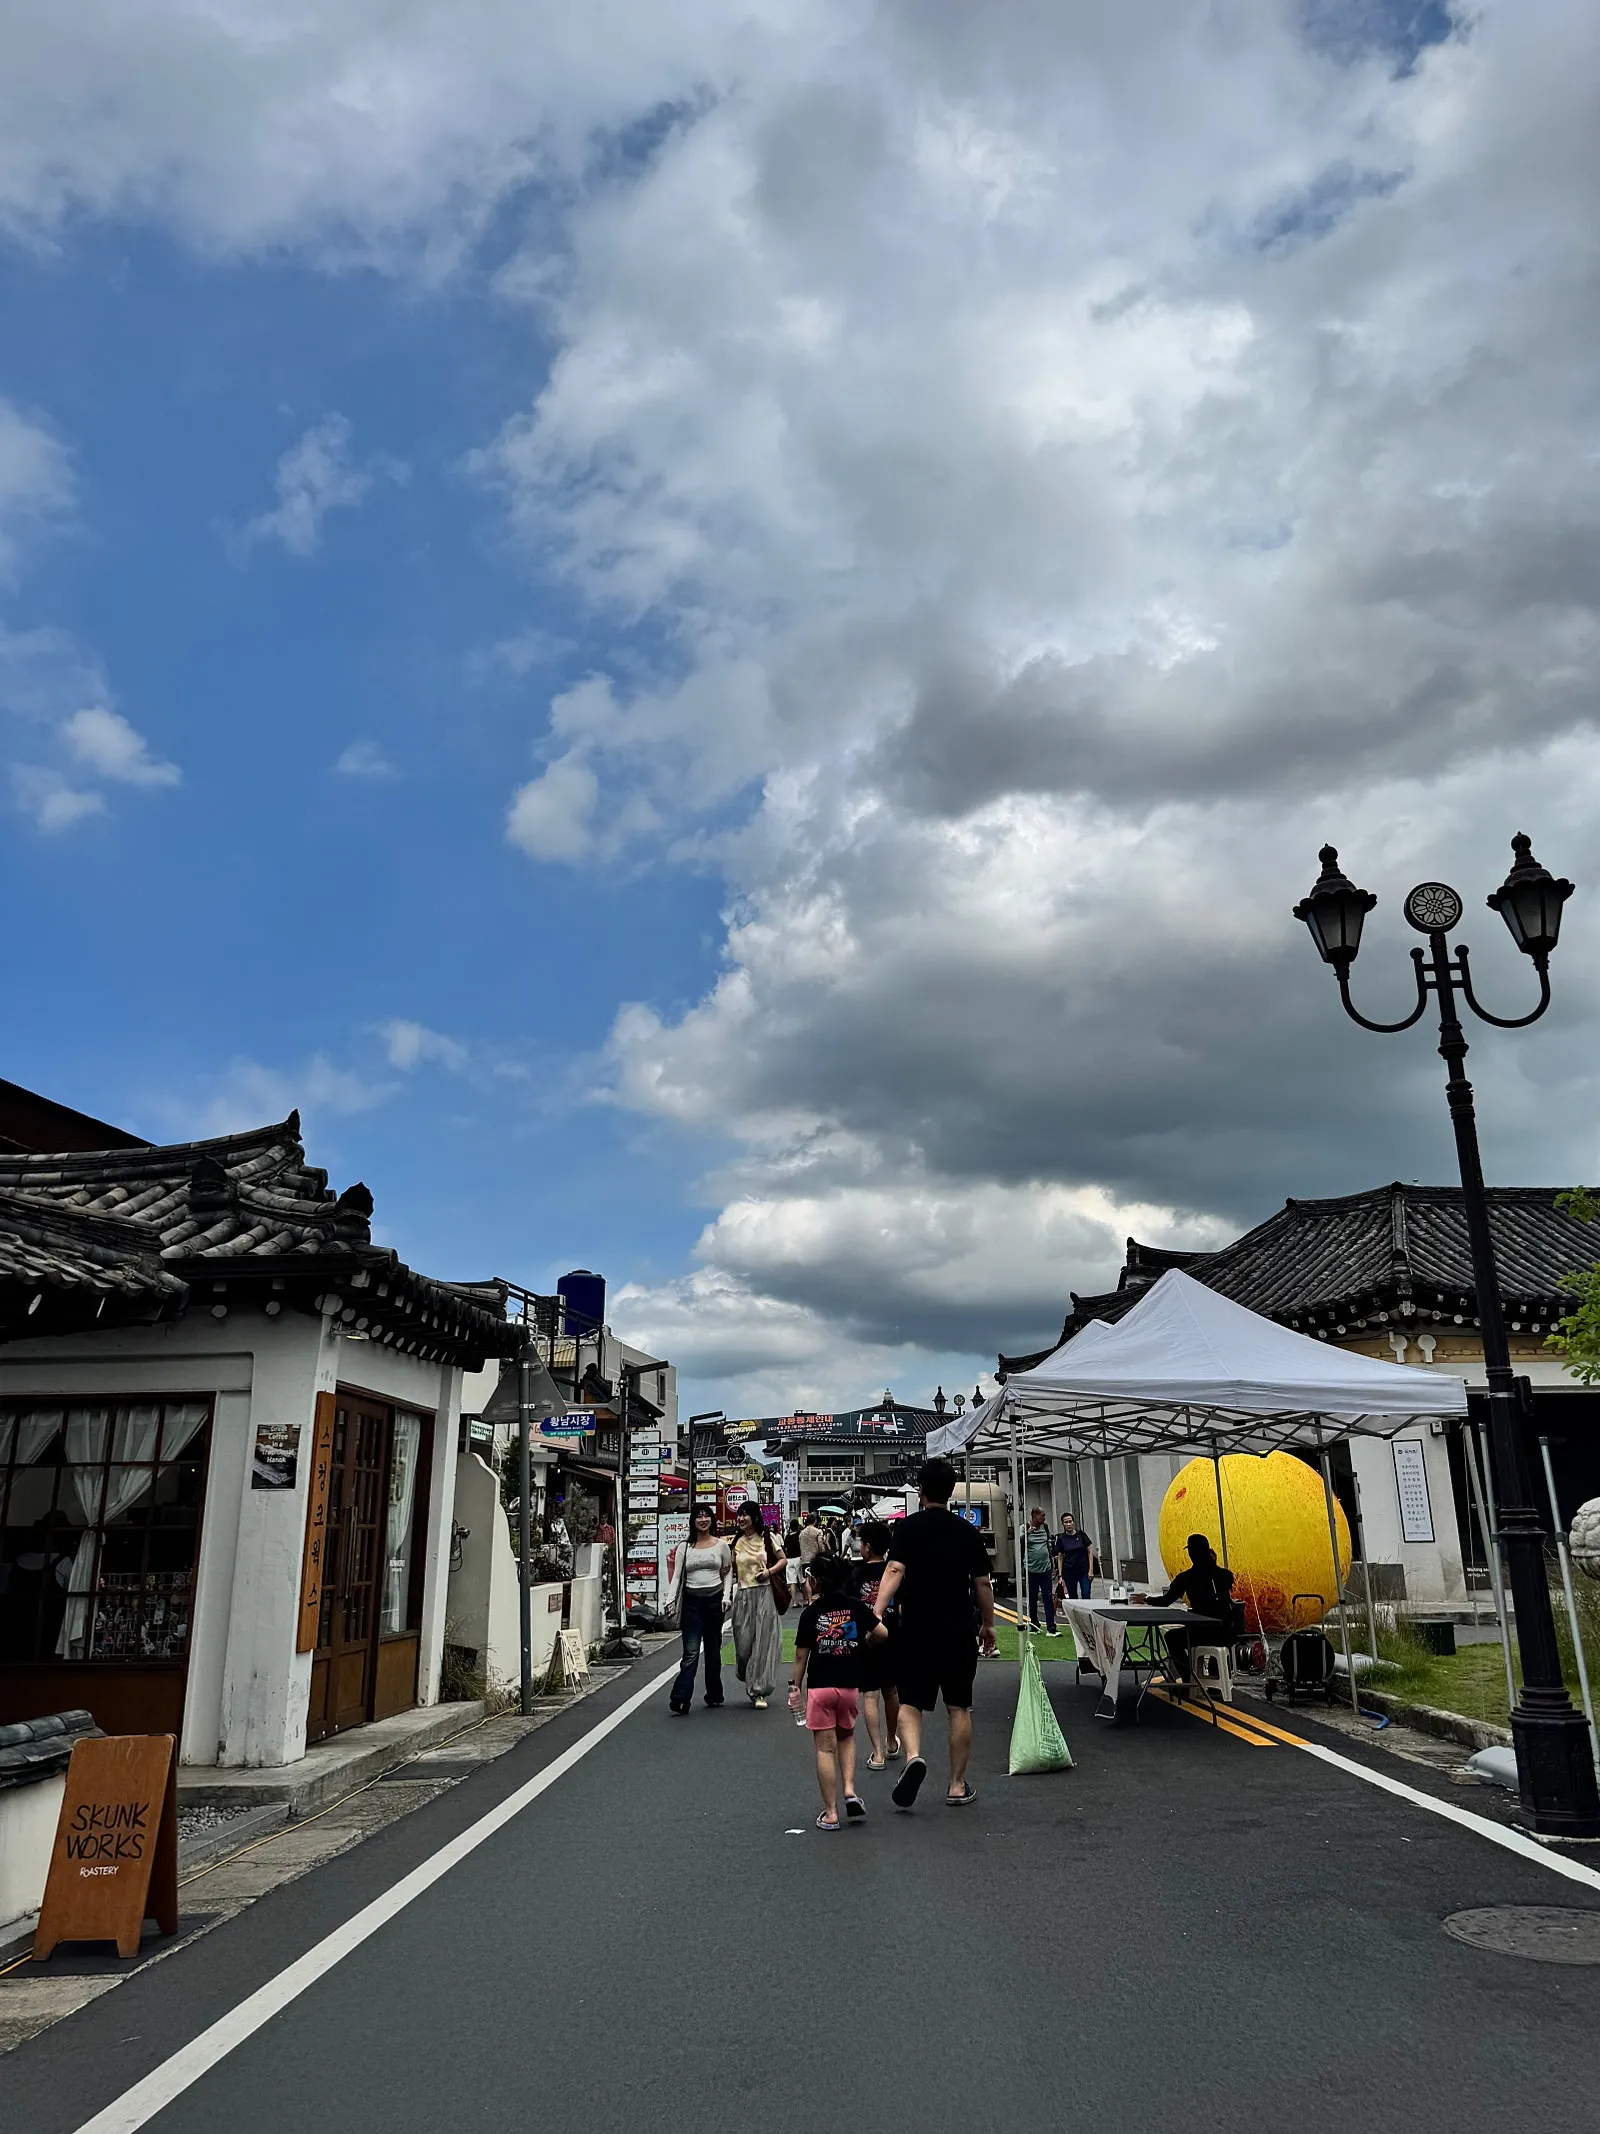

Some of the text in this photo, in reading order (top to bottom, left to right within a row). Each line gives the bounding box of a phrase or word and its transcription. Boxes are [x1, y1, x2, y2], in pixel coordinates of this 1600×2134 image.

[550, 1416, 590, 1426] 황남시장
[70, 1802, 150, 1831] SKUNK
[67, 1833, 145, 1859] WORKS
[80, 1866, 119, 1877] ROASTERY
